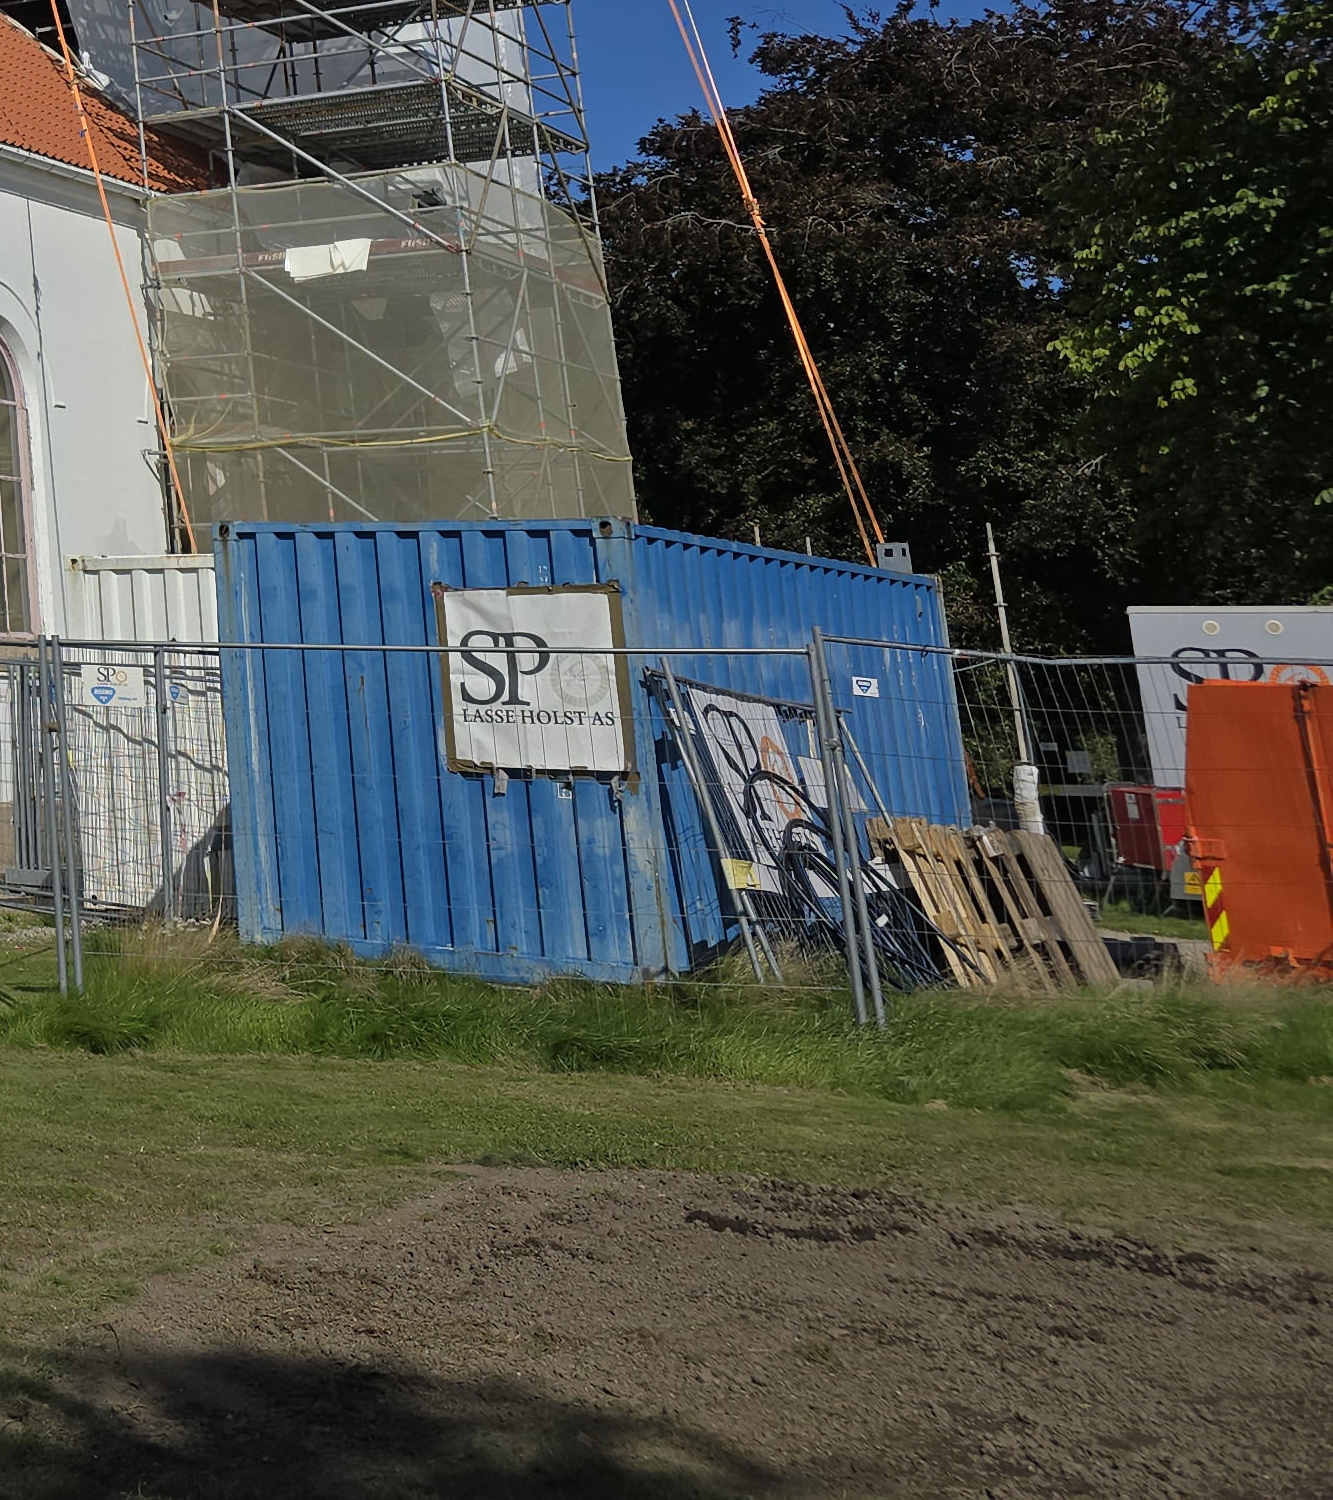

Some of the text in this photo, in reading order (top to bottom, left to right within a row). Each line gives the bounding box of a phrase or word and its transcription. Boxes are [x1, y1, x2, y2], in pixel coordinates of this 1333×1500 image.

[462, 708, 616, 727] LASSE HOLST AS
